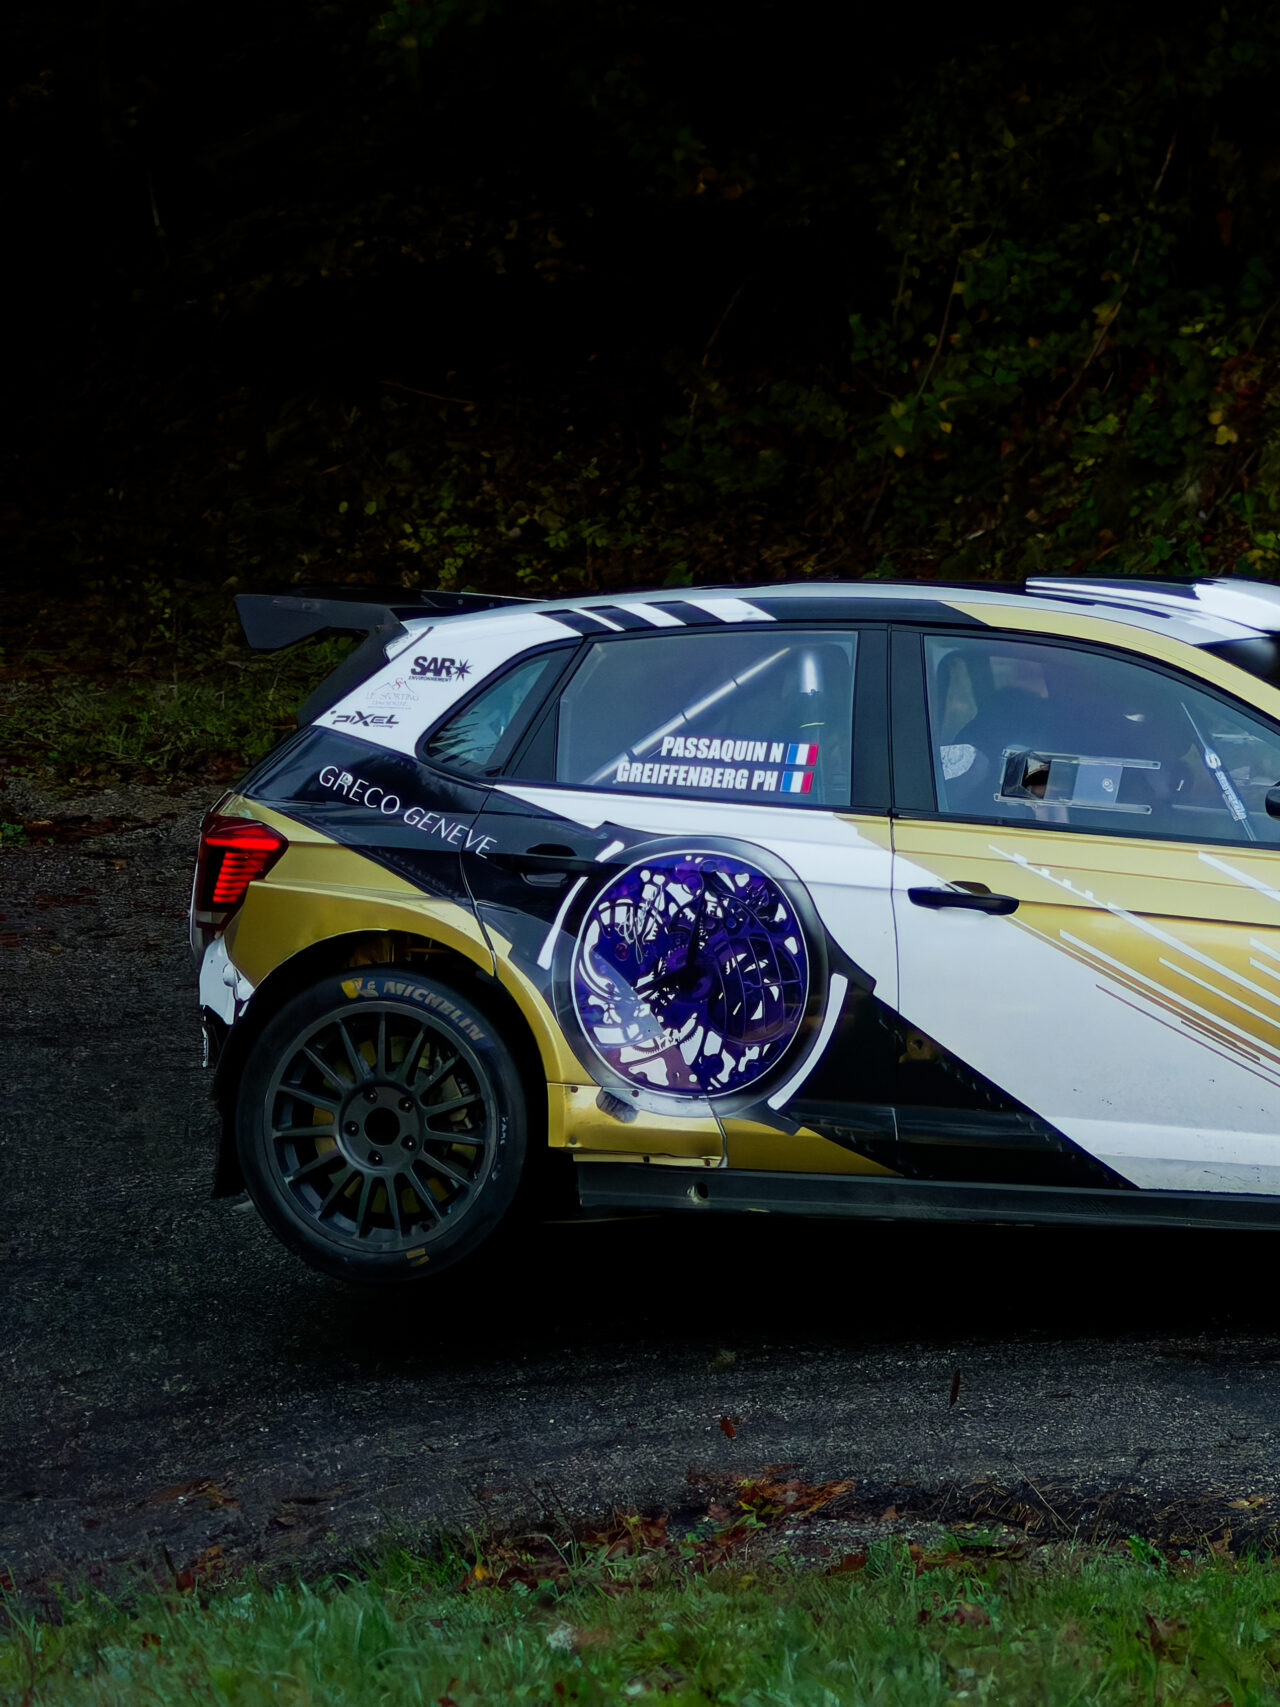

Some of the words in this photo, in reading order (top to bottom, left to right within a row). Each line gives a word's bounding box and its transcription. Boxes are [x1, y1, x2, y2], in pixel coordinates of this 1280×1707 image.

[411, 656, 456, 677] SAR
[660, 736, 768, 763] PASSAQUIN
[769, 743, 785, 763] N
[616, 762, 749, 790] GREIFFENBERG
[751, 770, 779, 792] PH
[319, 765, 401, 815] GRECO
[403, 806, 498, 860] GENEVE
[383, 980, 486, 1042] MICHELIN
